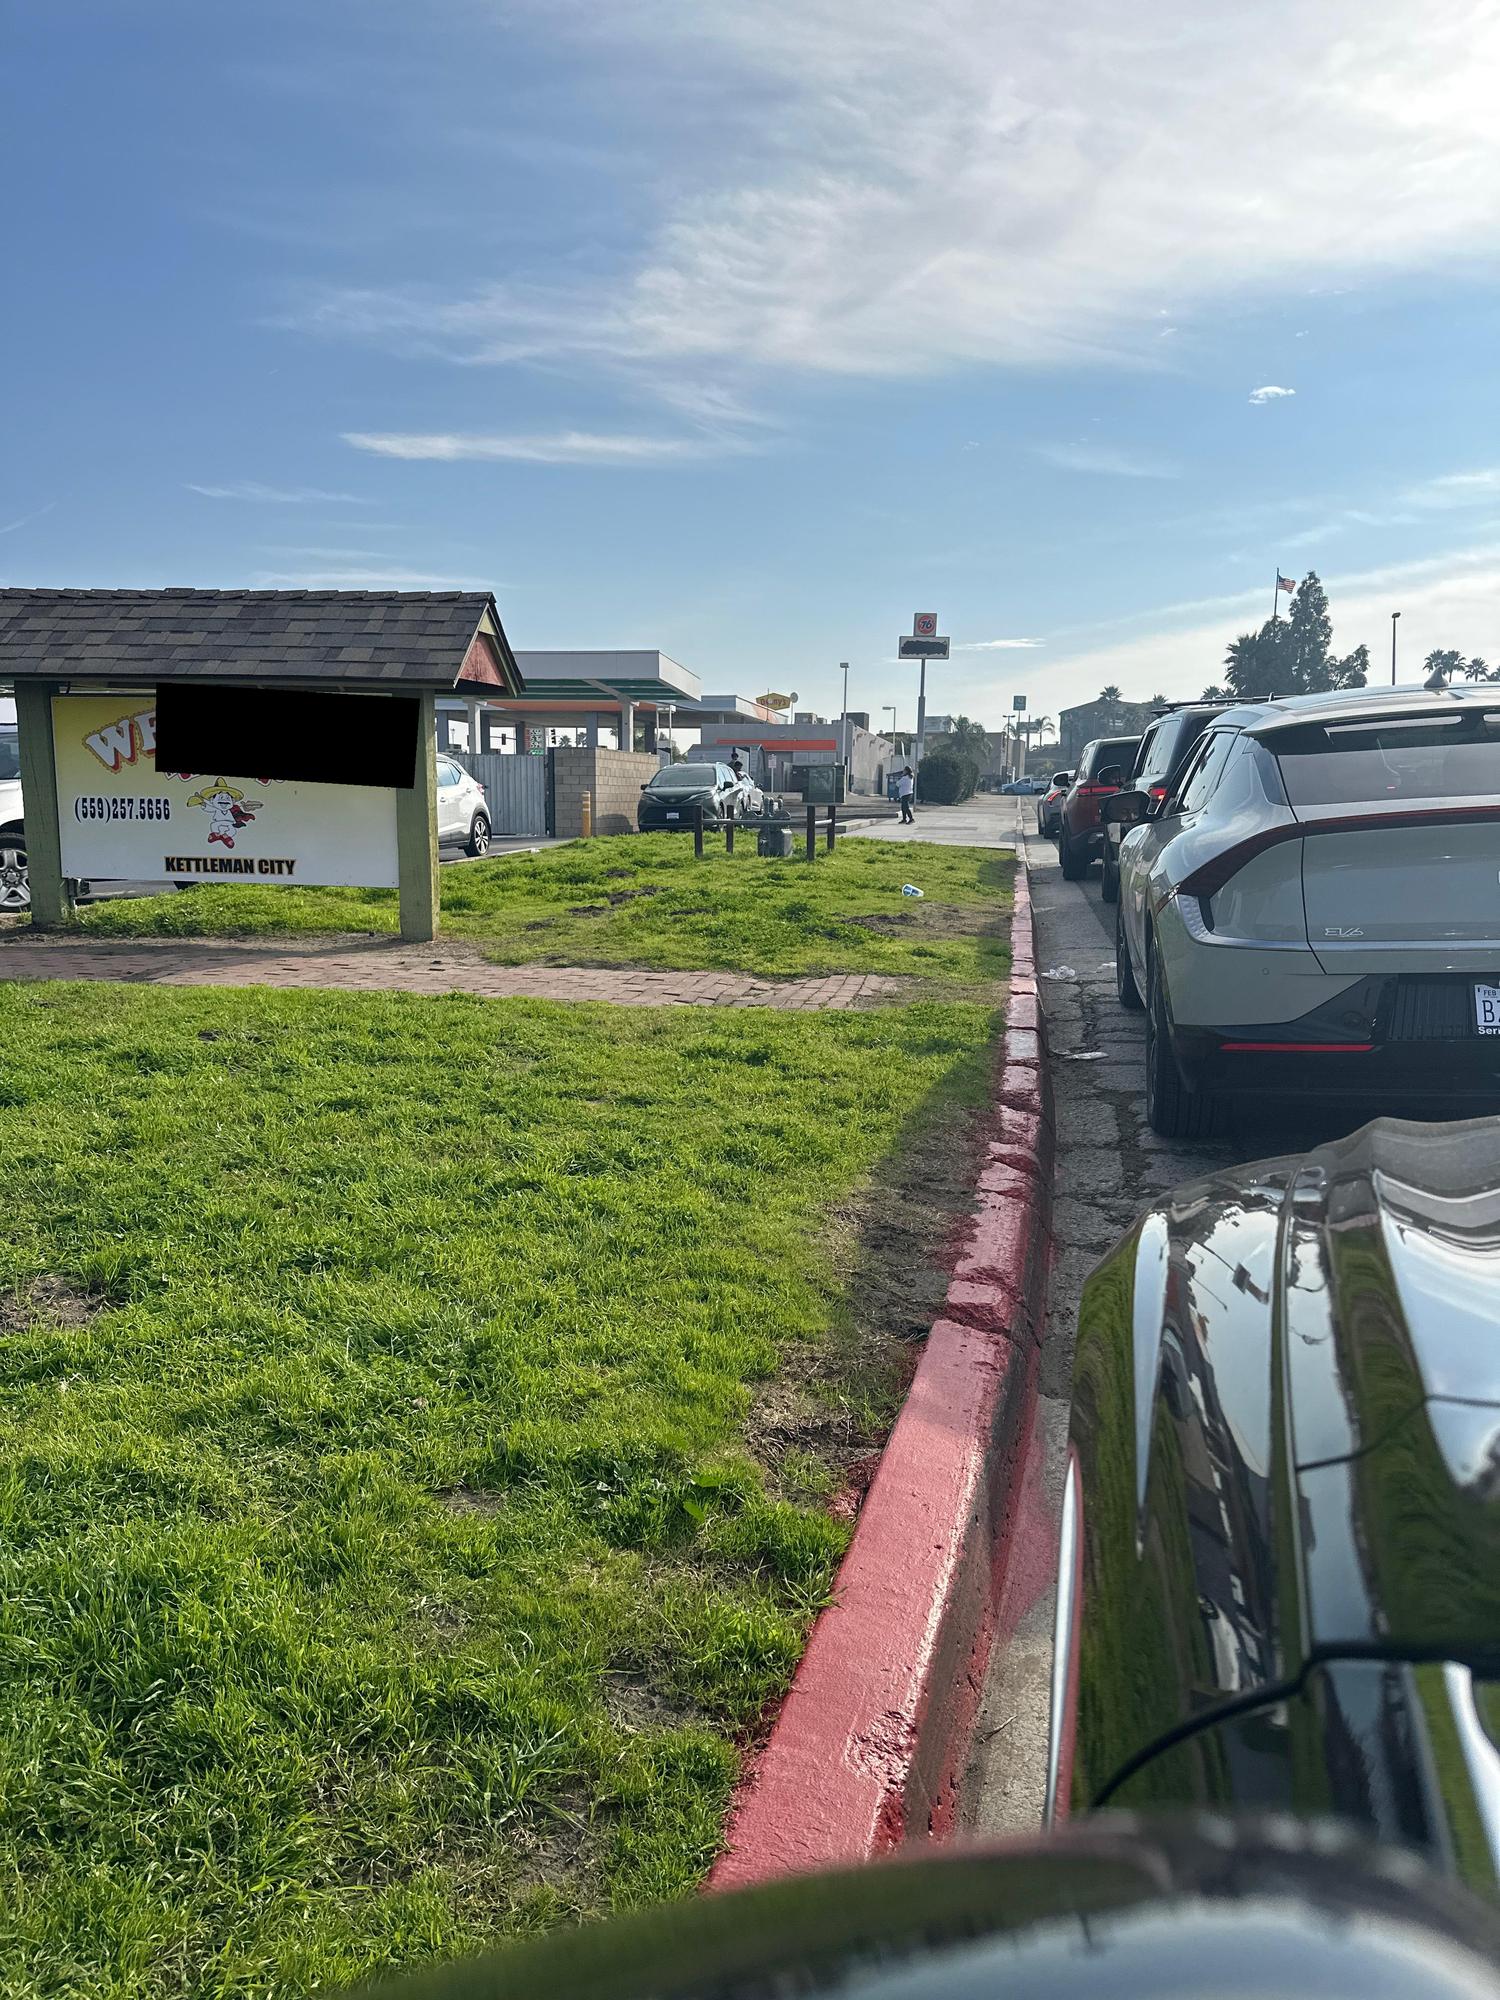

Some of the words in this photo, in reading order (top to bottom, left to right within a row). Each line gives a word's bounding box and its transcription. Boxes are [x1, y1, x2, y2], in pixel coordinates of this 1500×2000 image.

[920, 620, 932, 630] 76
[74, 796, 171, 823] (559)257.5656
[164, 856, 255, 875] KETTLEMAN
[257, 858, 297, 876] CITY
[1324, 927, 1365, 937] EV6
[1478, 1026, 1500, 1036] Ser
